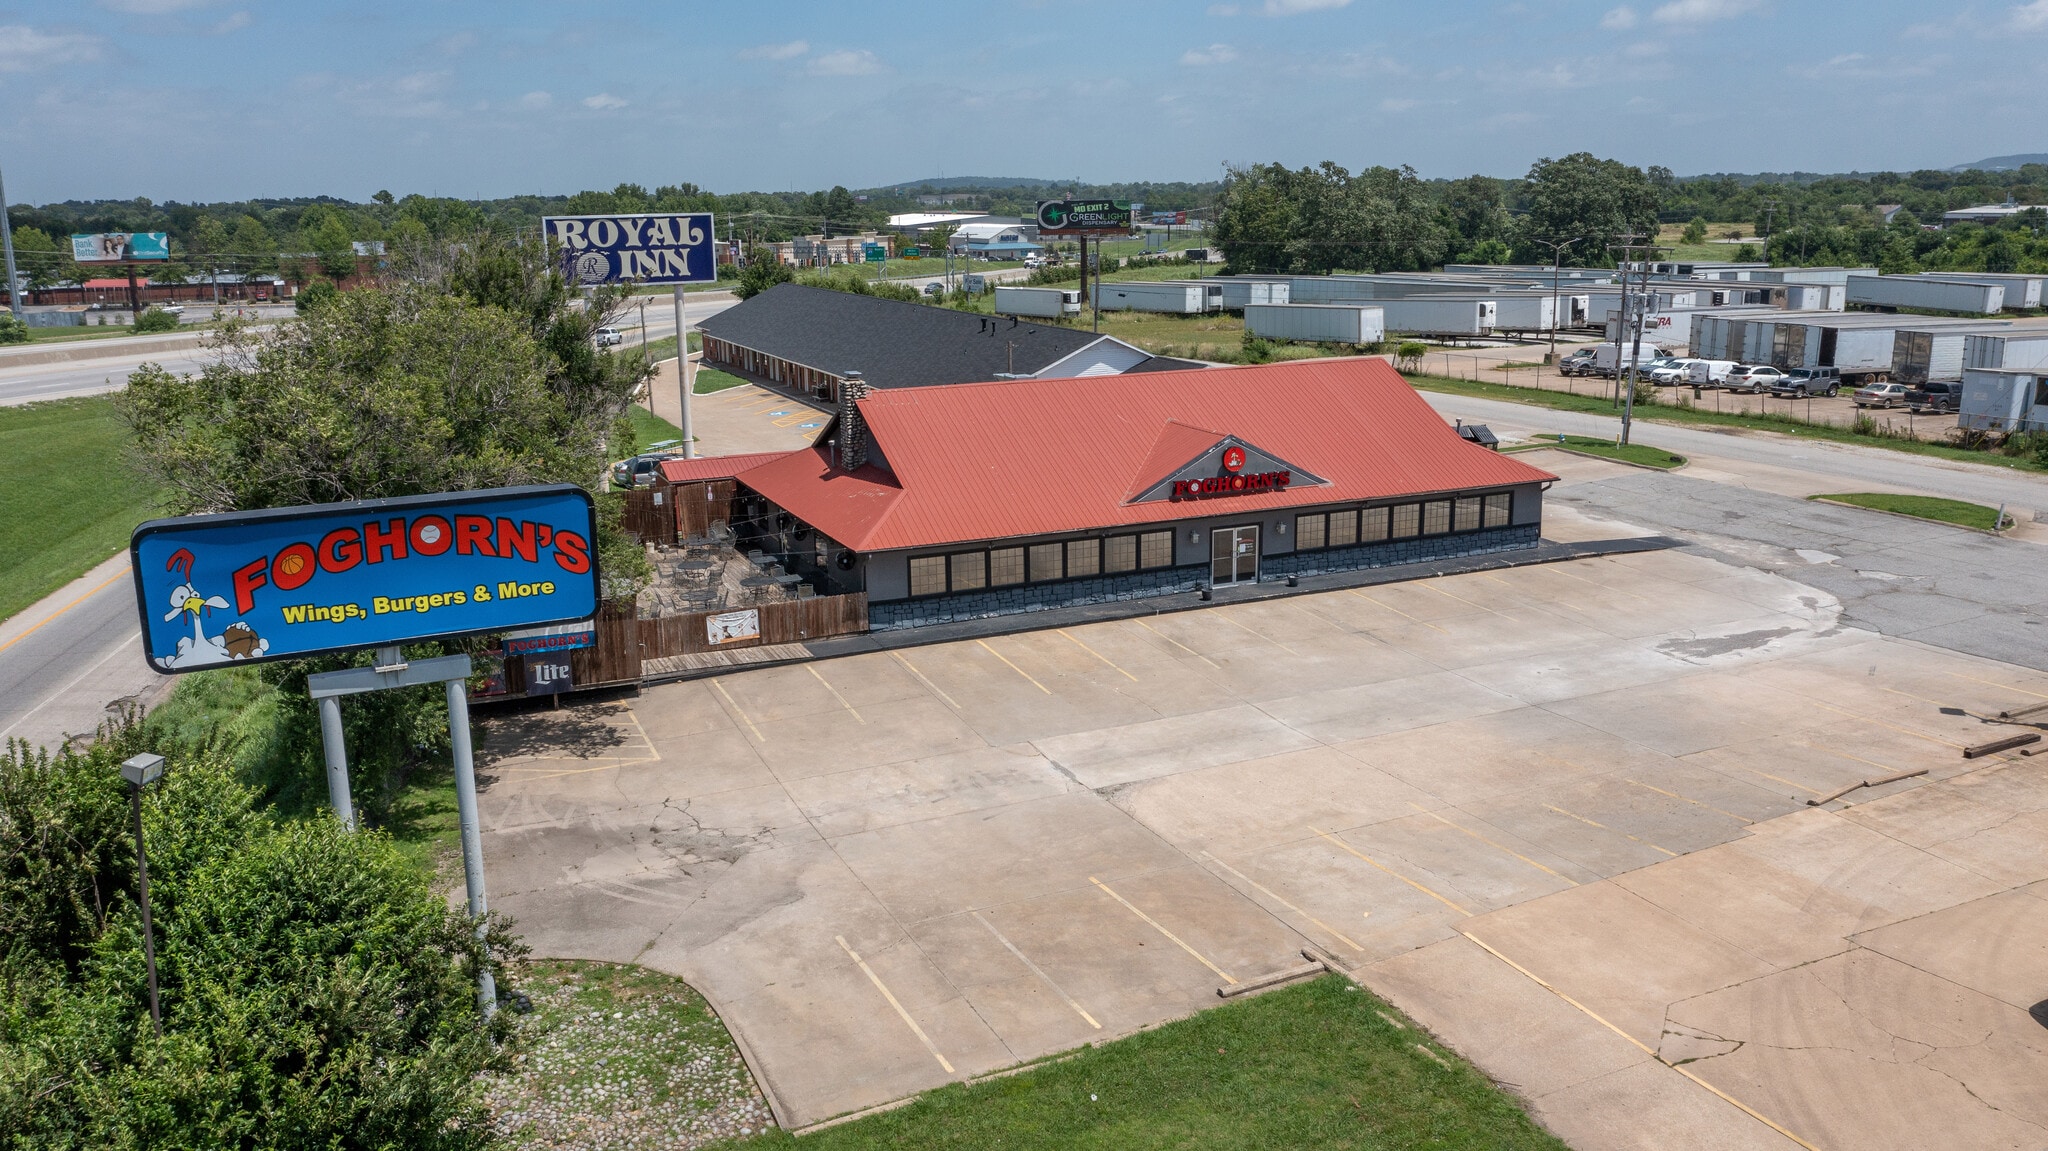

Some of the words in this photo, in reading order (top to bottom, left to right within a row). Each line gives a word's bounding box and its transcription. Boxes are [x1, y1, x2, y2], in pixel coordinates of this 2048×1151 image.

[1069, 212, 1129, 222] GREENLIGHT
[1086, 203, 1103, 212] EXIT
[553, 217, 704, 249] ROYAL
[618, 248, 691, 278] INN
[1174, 471, 1290, 496] FOGHORN'S
[232, 514, 592, 615] FOGHORN'S
[281, 599, 368, 625] Wings,
[373, 588, 467, 615] Burgers
[473, 585, 492, 602] &
[497, 579, 555, 600] More
[509, 634, 589, 652] FOGHORN'S
[534, 664, 570, 685] Lite
